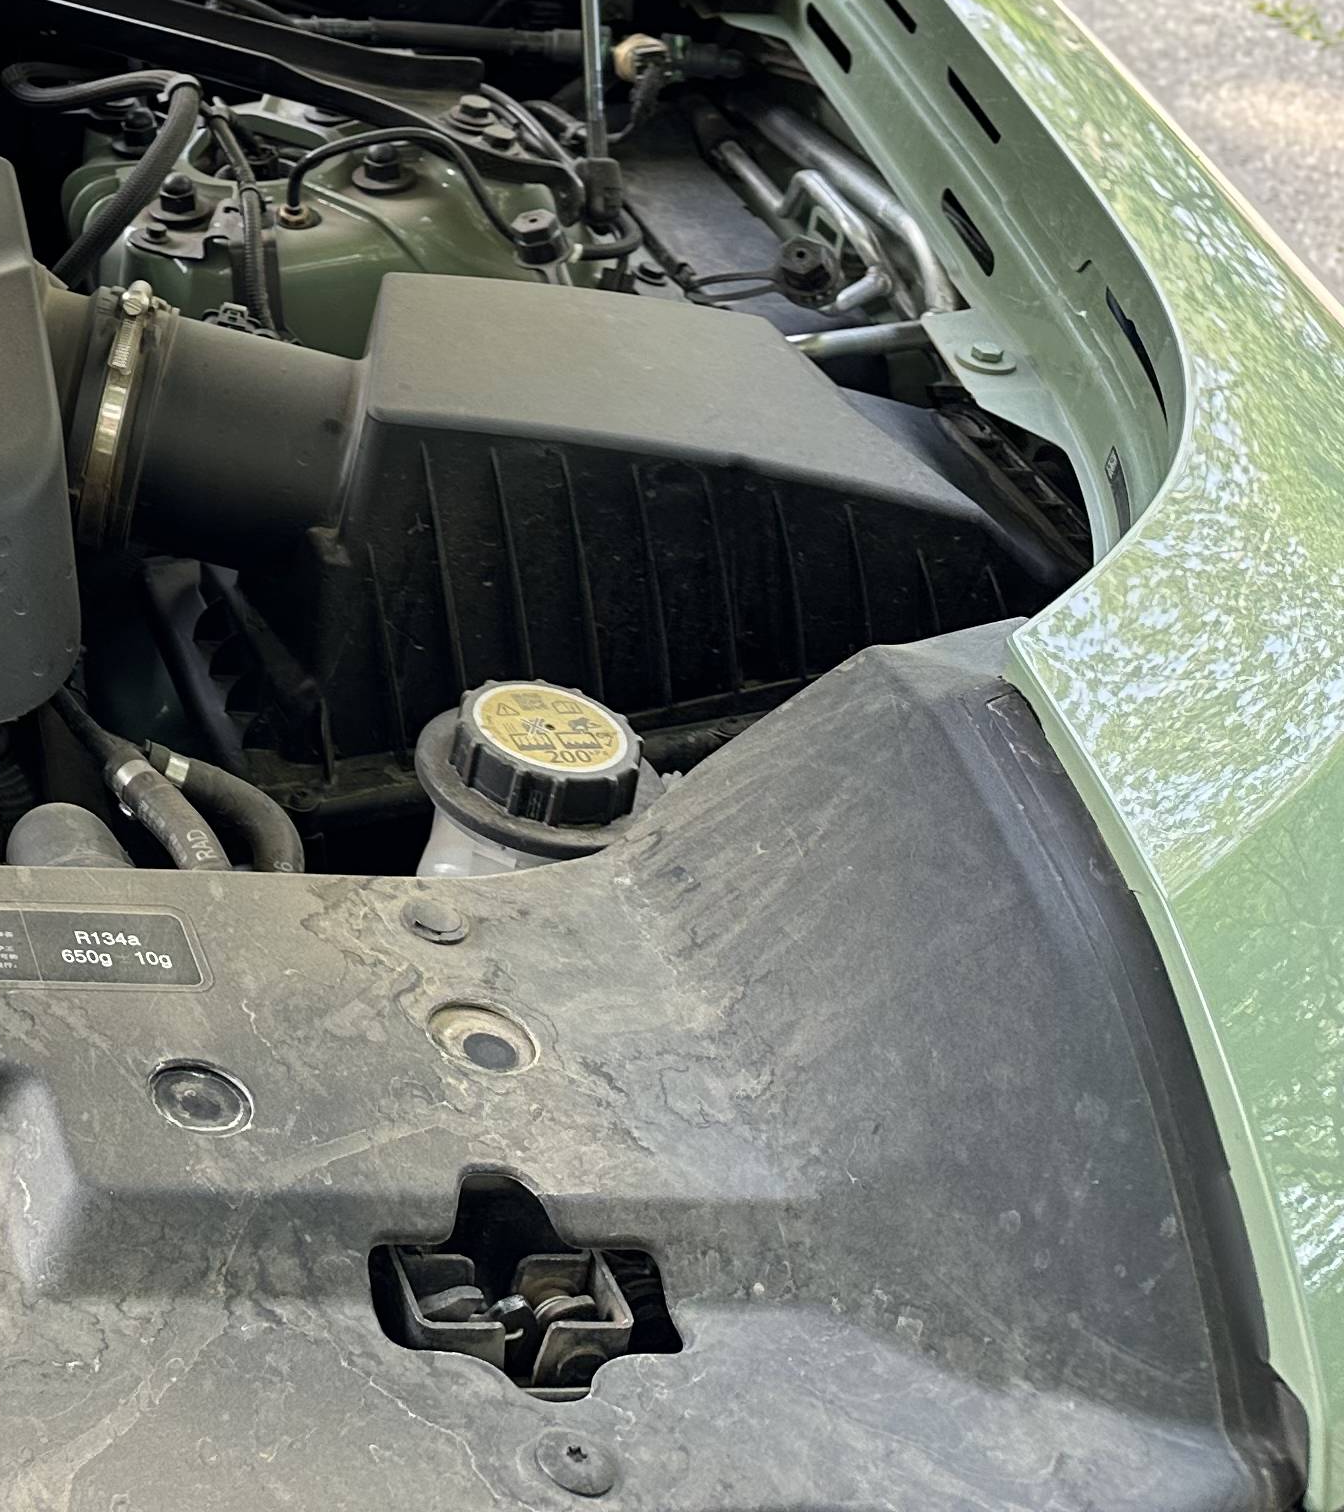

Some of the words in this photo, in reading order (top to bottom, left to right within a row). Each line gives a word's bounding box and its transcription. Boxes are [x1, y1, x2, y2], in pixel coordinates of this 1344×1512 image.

[545, 750, 592, 764] 200
[186, 829, 218, 861] RAD
[73, 930, 141, 947] R134a
[61, 949, 113, 968] 650g
[134, 951, 173, 969] 10g
